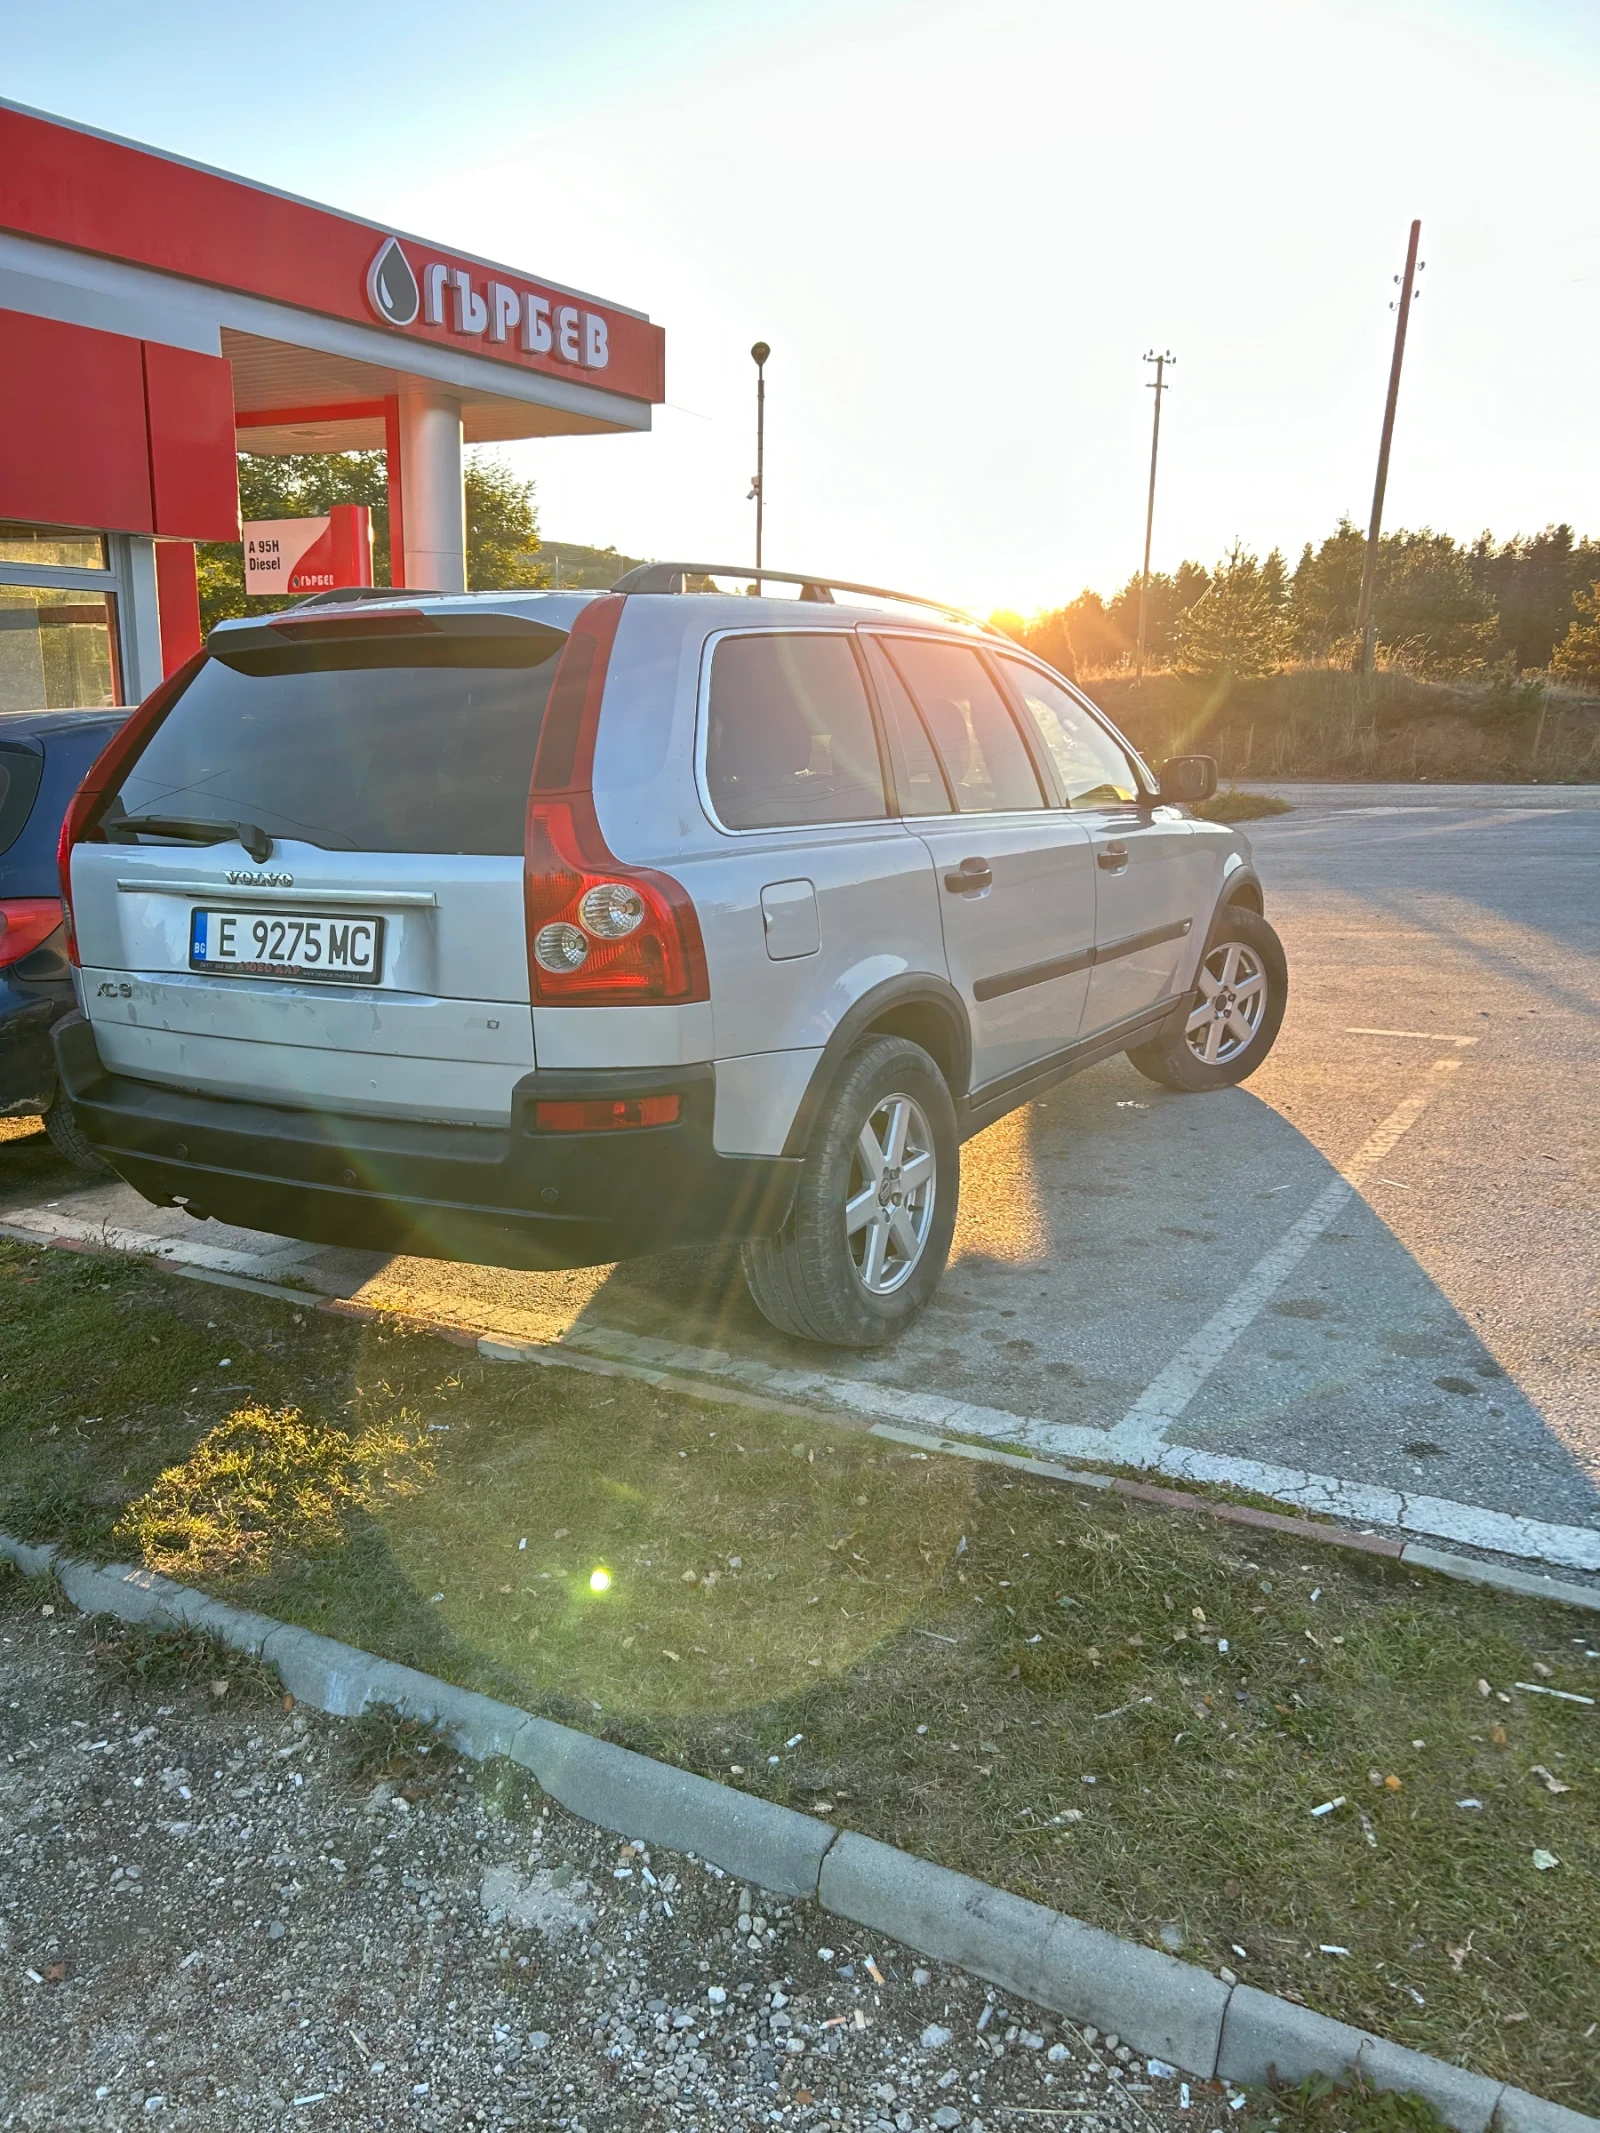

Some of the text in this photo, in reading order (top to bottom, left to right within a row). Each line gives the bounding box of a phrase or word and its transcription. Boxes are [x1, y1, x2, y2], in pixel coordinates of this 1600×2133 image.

[424, 262, 609, 370] ГЪРБЕВ
[249, 557, 280, 570] Diesel
[223, 870, 294, 887] VOLVO
[195, 943, 206, 954] BG
[220, 918, 371, 966] E 9275 MC
